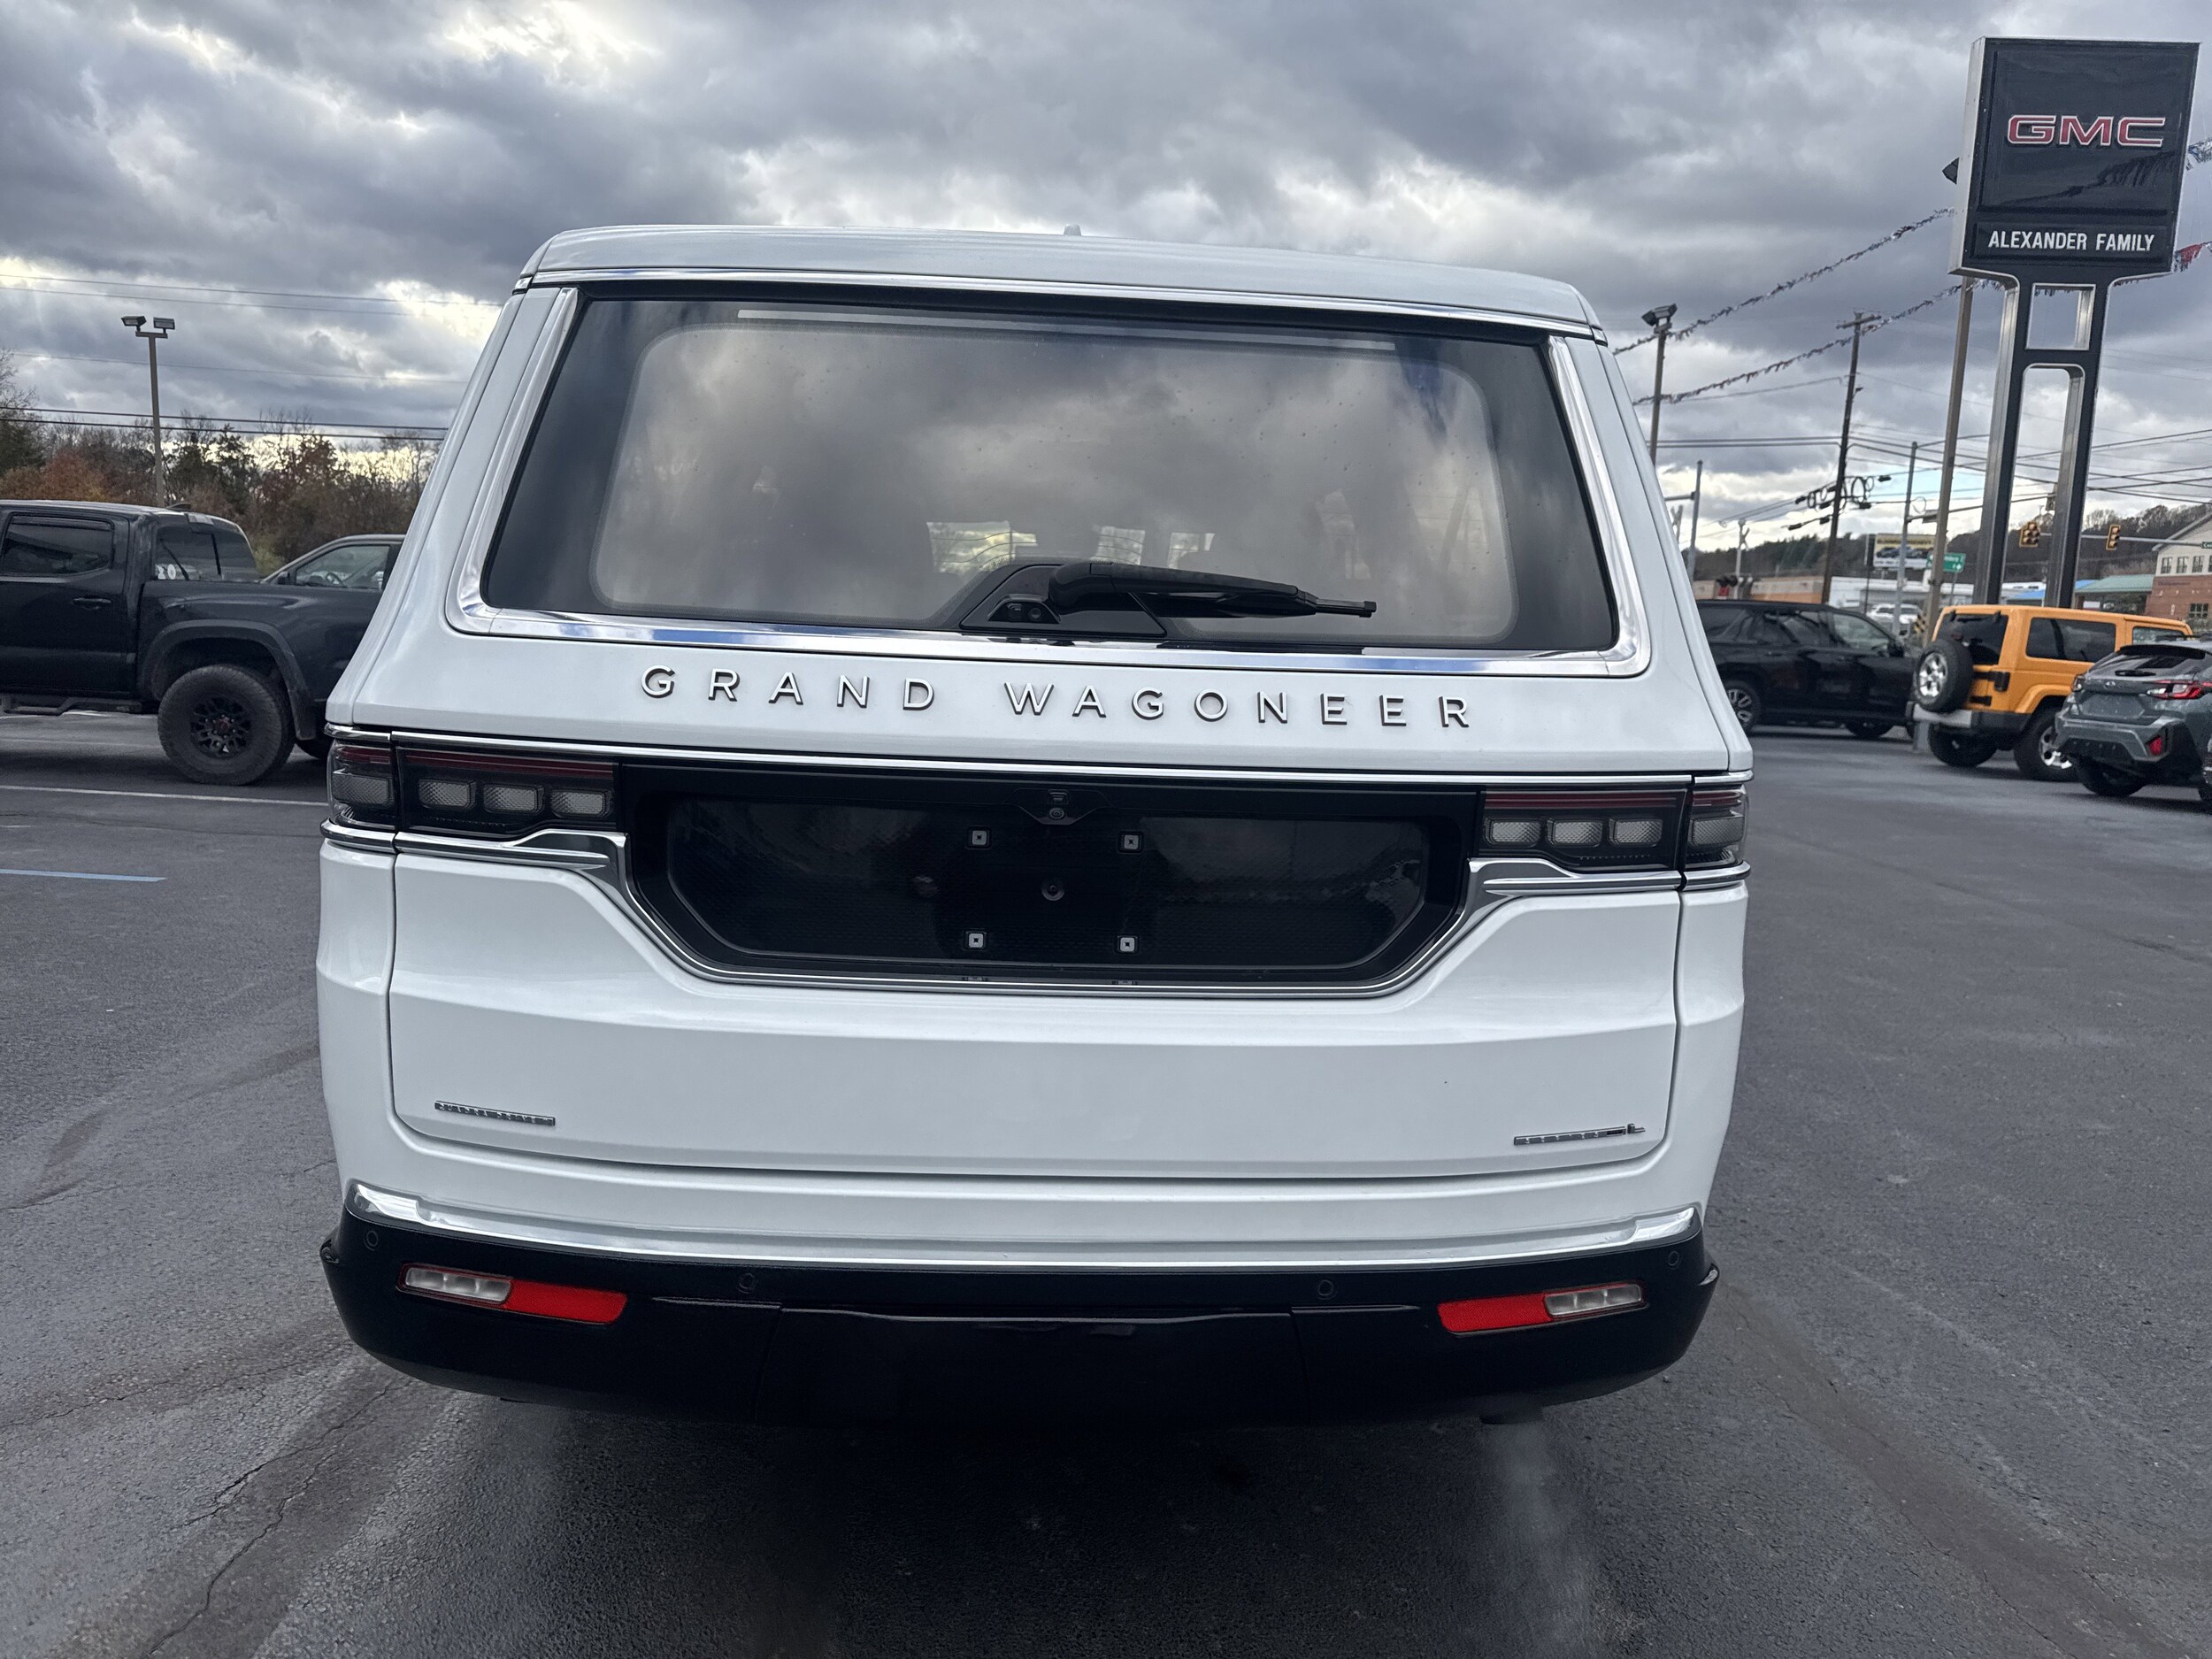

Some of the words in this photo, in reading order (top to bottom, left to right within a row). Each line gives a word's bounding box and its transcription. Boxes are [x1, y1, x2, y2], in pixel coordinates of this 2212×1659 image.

[2008, 114, 2166, 148] GMC
[1988, 230, 2088, 250] ALEXANDER
[2095, 233, 2155, 252] FAMILY
[641, 664, 934, 710] GRAND
[1003, 680, 1470, 728] WAGONEER
